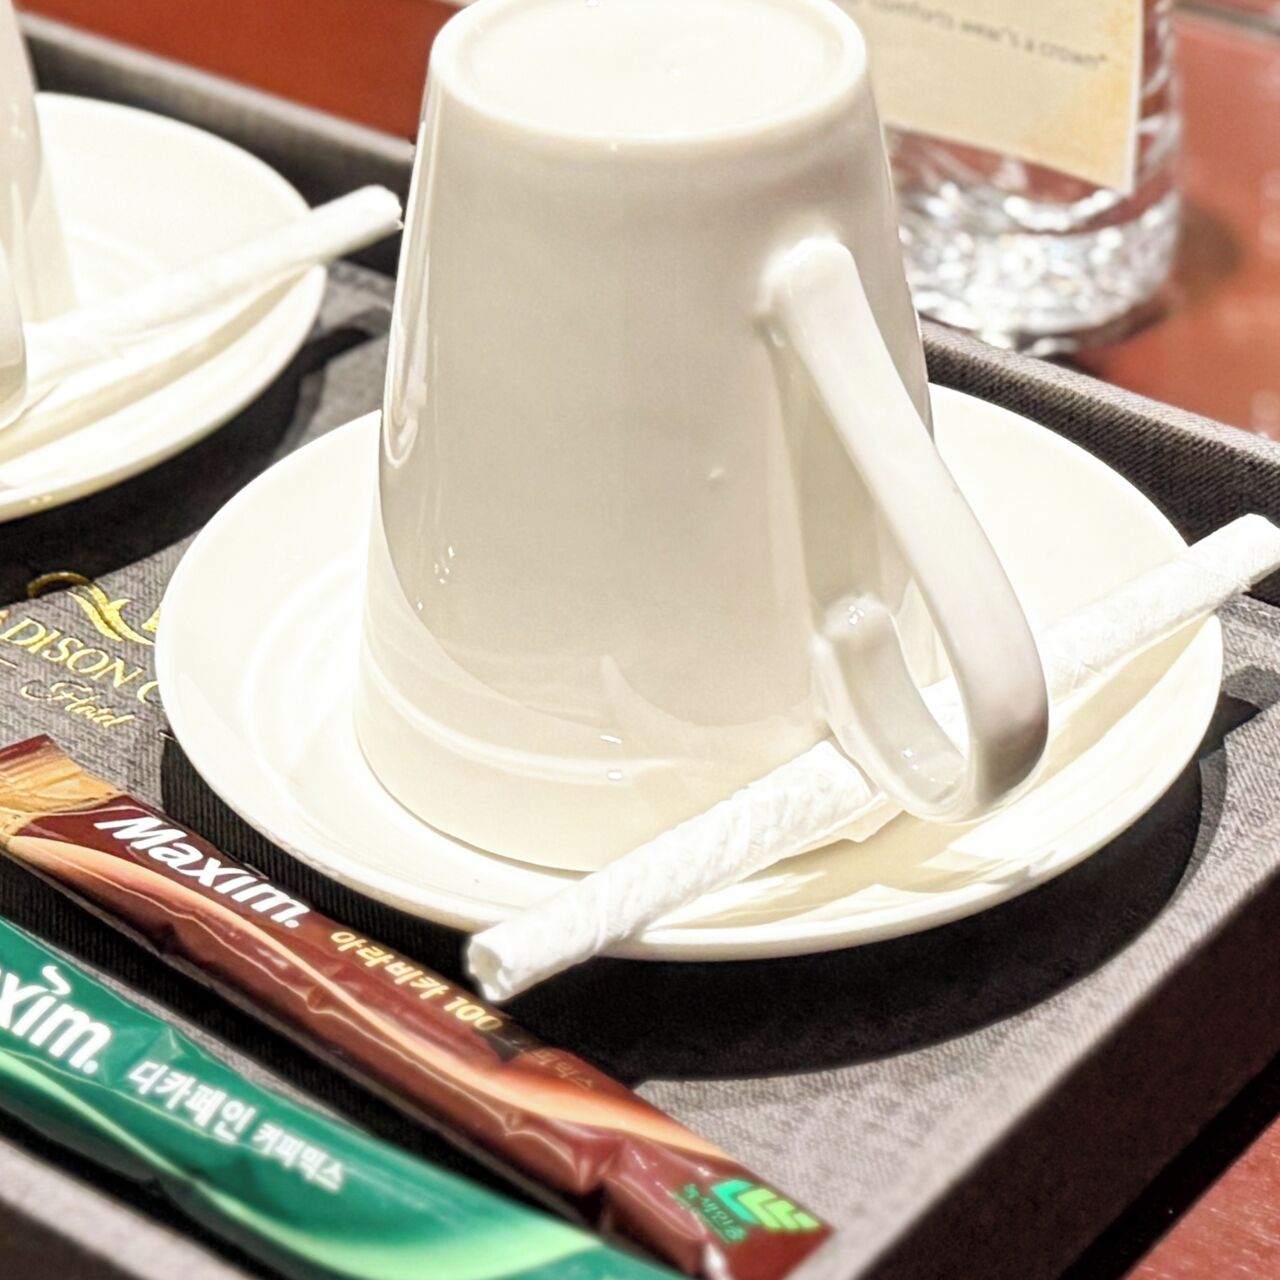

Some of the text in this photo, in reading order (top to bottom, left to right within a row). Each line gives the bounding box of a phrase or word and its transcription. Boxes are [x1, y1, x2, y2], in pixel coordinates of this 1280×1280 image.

[330, 931, 504, 1032] 아라비카 100
[127, 1060, 347, 1194] 디카페인 커피믹스
